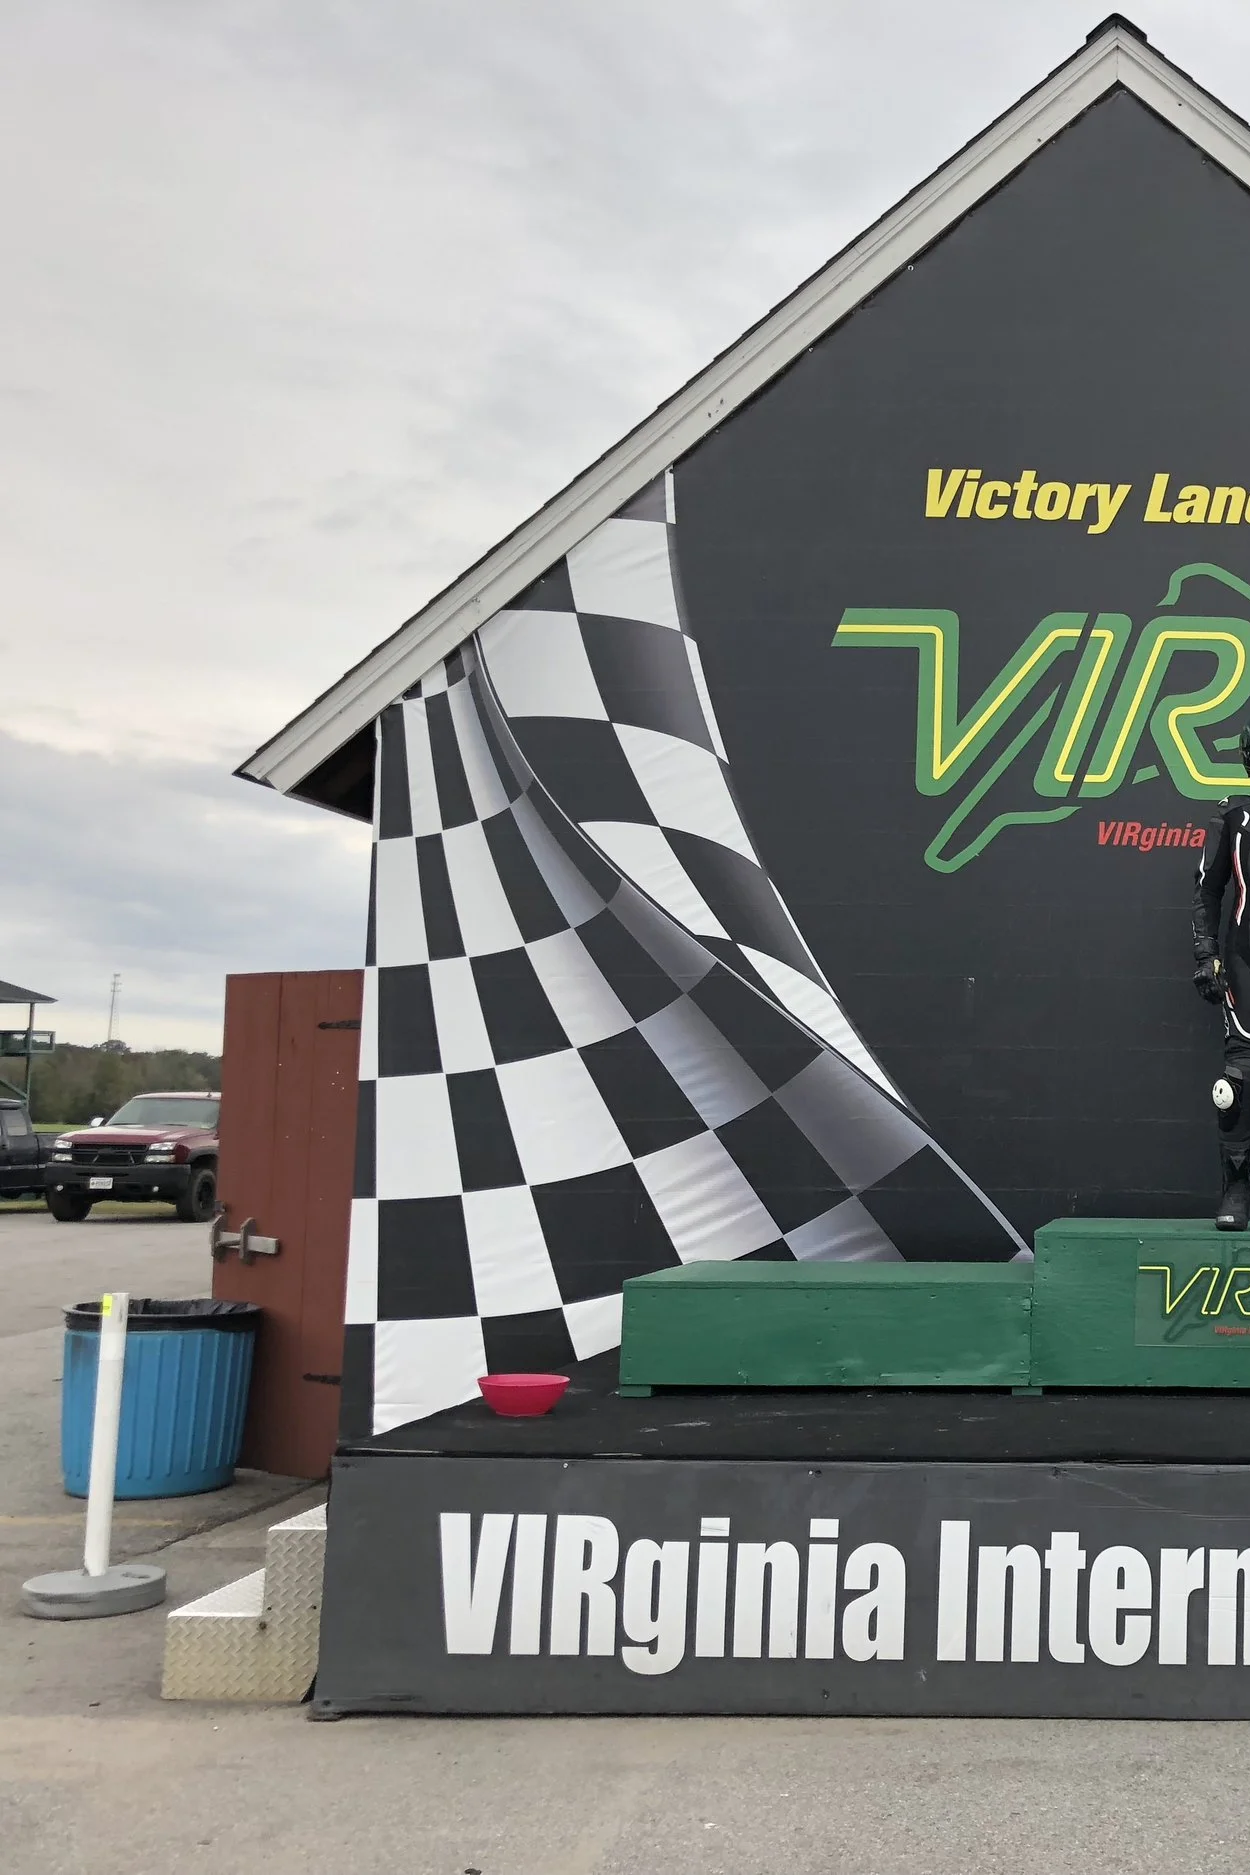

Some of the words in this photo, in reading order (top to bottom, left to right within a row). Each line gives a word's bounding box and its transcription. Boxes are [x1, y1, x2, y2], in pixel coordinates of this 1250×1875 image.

[925, 468, 1132, 534] Victory
[1097, 821, 1207, 853] VIRginia
[438, 1512, 907, 1675] VIRginia
